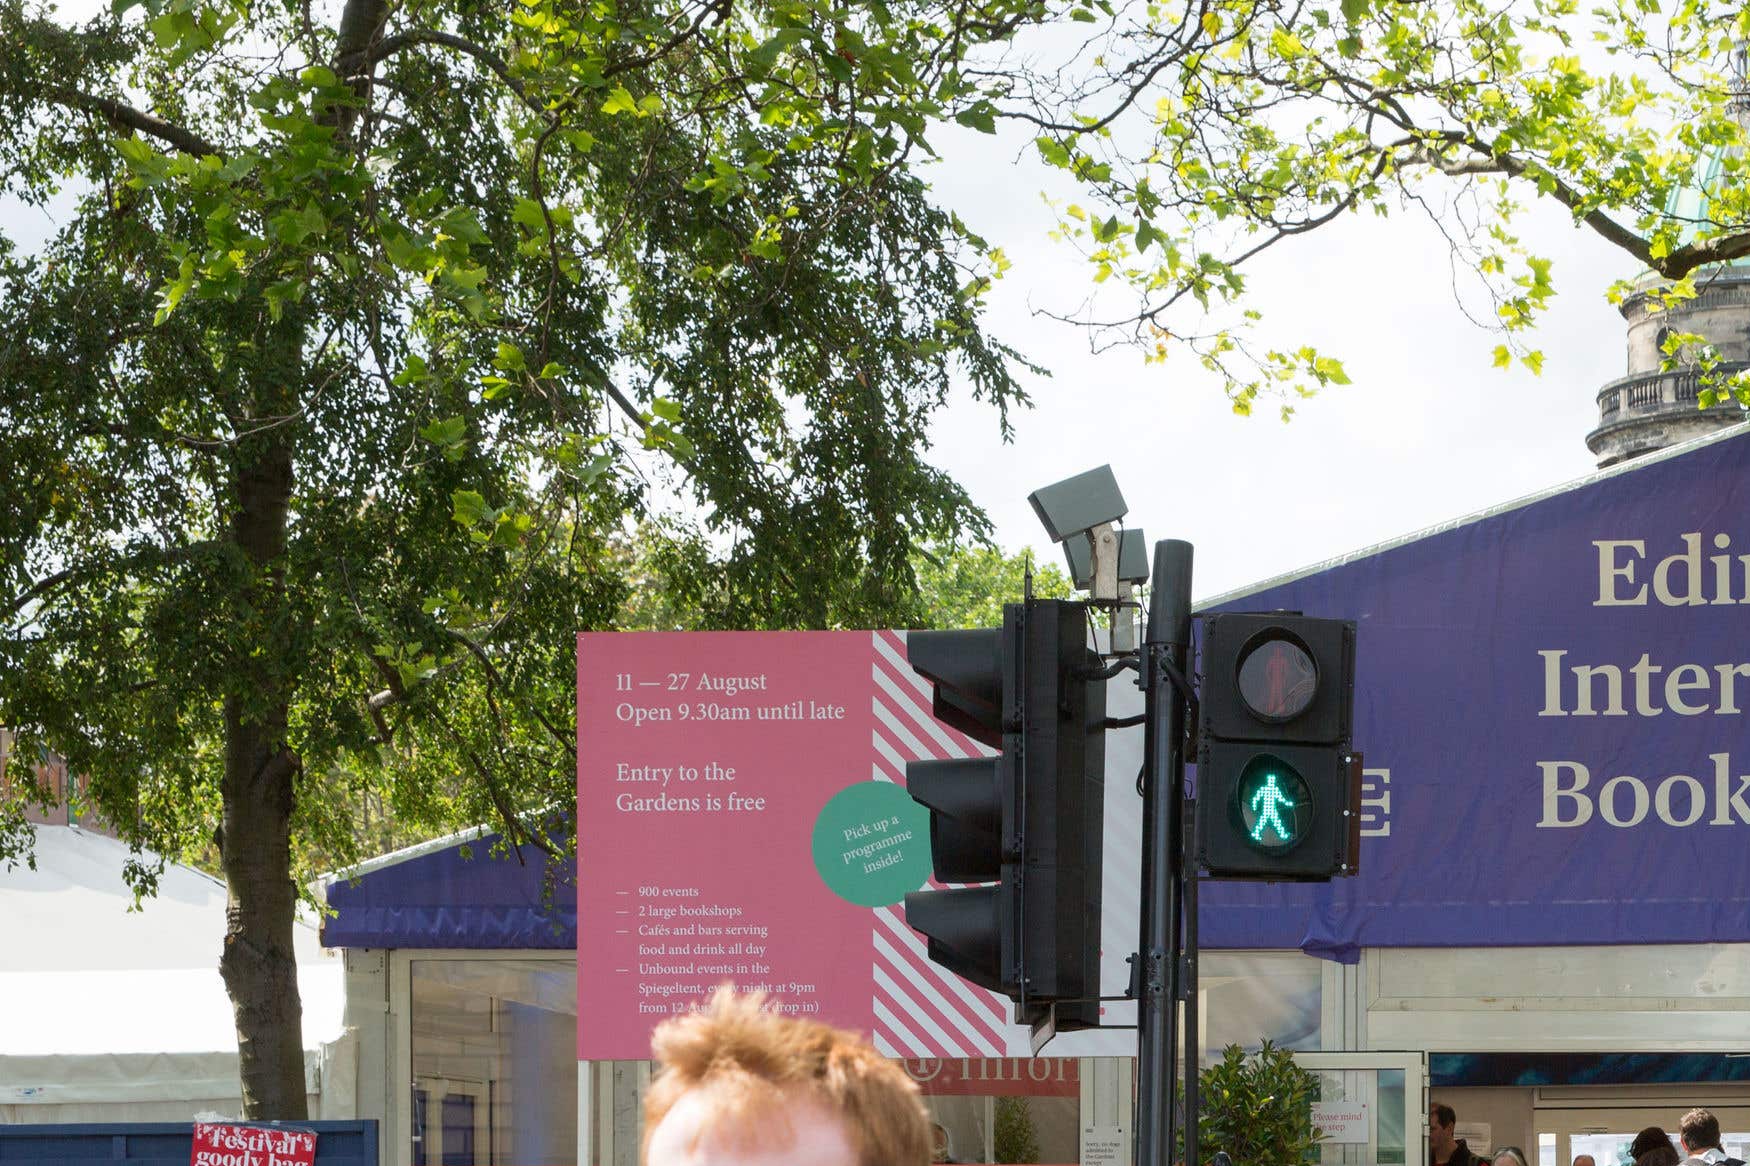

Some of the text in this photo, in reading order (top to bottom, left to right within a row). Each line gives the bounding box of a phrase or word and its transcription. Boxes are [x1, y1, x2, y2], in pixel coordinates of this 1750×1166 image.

[617, 673, 767, 696] 11 27 August
[616, 700, 845, 726] Open 9.30am until late
[616, 762, 736, 787] Entry to the
[616, 792, 766, 812] Gardens is free
[843, 816, 899, 840] Pick up a
[843, 830, 912, 864] programme
[864, 850, 903, 873] inside!
[639, 887, 698, 896] 900 events
[639, 905, 742, 919] 2 large bookshops
[639, 925, 768, 938] Cafés and bars serving
[639, 943, 766, 957] food and drink all day
[639, 963, 769, 974] Unbound events in the
[743, 983, 772, 995] night
[776, 984, 786, 992] at
[789, 983, 816, 996] 9pm
[639, 1002, 666, 1014] from
[672, 1002, 683, 1013] 12
[803, 1002, 819, 1014] in)
[1313, 1112, 1362, 1121] Please mind
[212, 1129, 296, 1155] Festival
